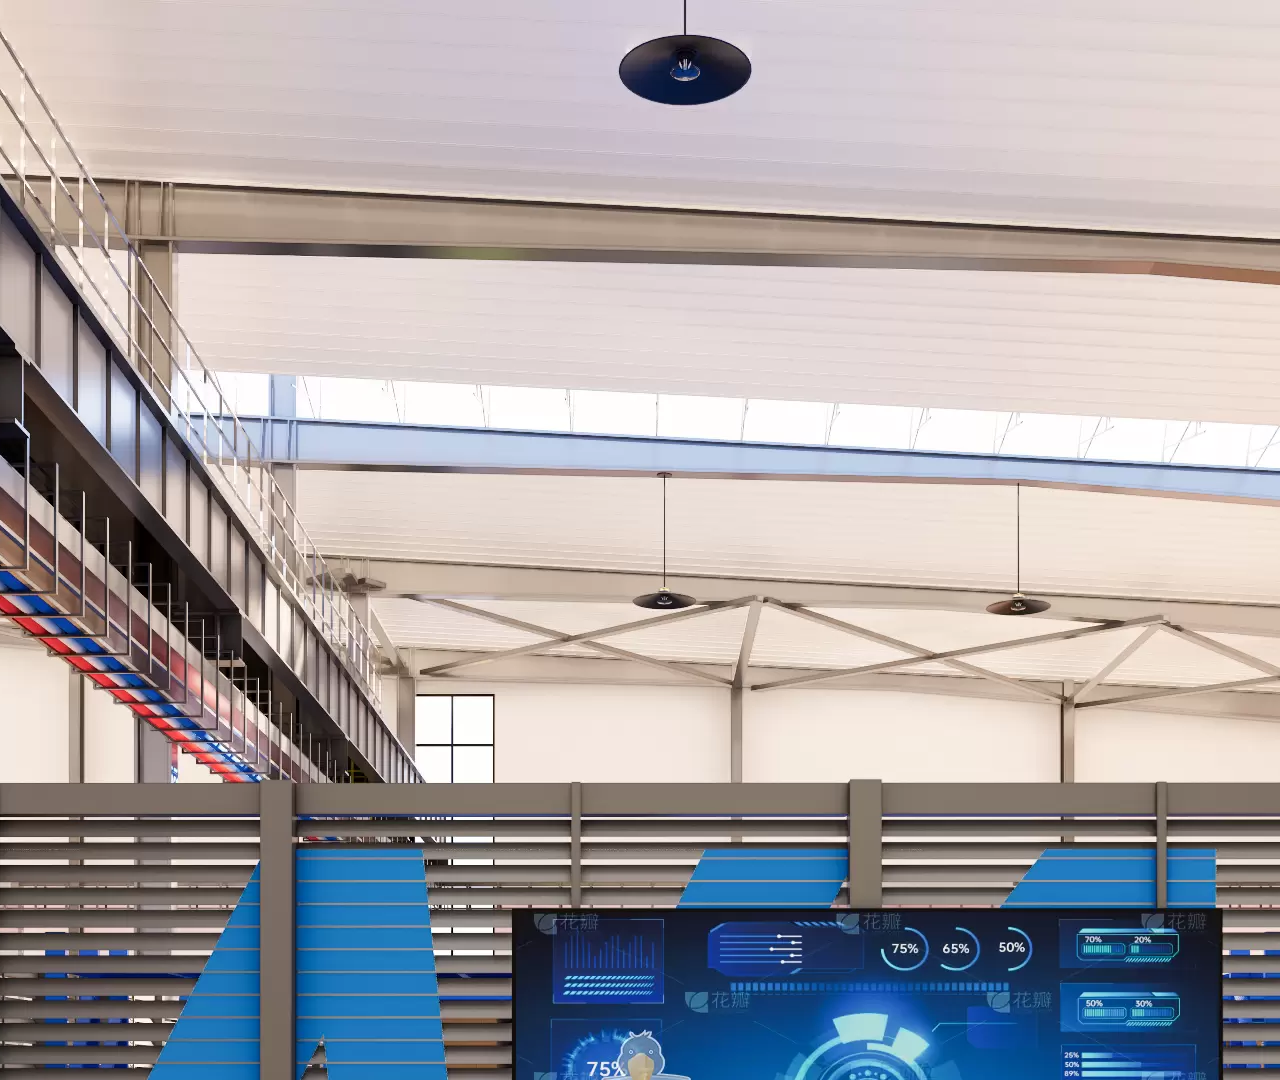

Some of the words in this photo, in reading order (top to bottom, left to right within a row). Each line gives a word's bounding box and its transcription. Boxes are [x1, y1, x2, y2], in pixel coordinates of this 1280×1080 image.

[863, 912, 901, 930] 花瓣
[1167, 912, 1207, 930] 花瓣
[891, 943, 919, 954] 75%
[942, 943, 970, 954] 65%
[998, 942, 1026, 954] 50%
[1084, 935, 1102, 943] 70%
[1134, 935, 1152, 943] 20%
[711, 991, 750, 1009] 花瓣
[1013, 991, 1052, 1009] 花瓣
[1086, 999, 1103, 1007] 50%
